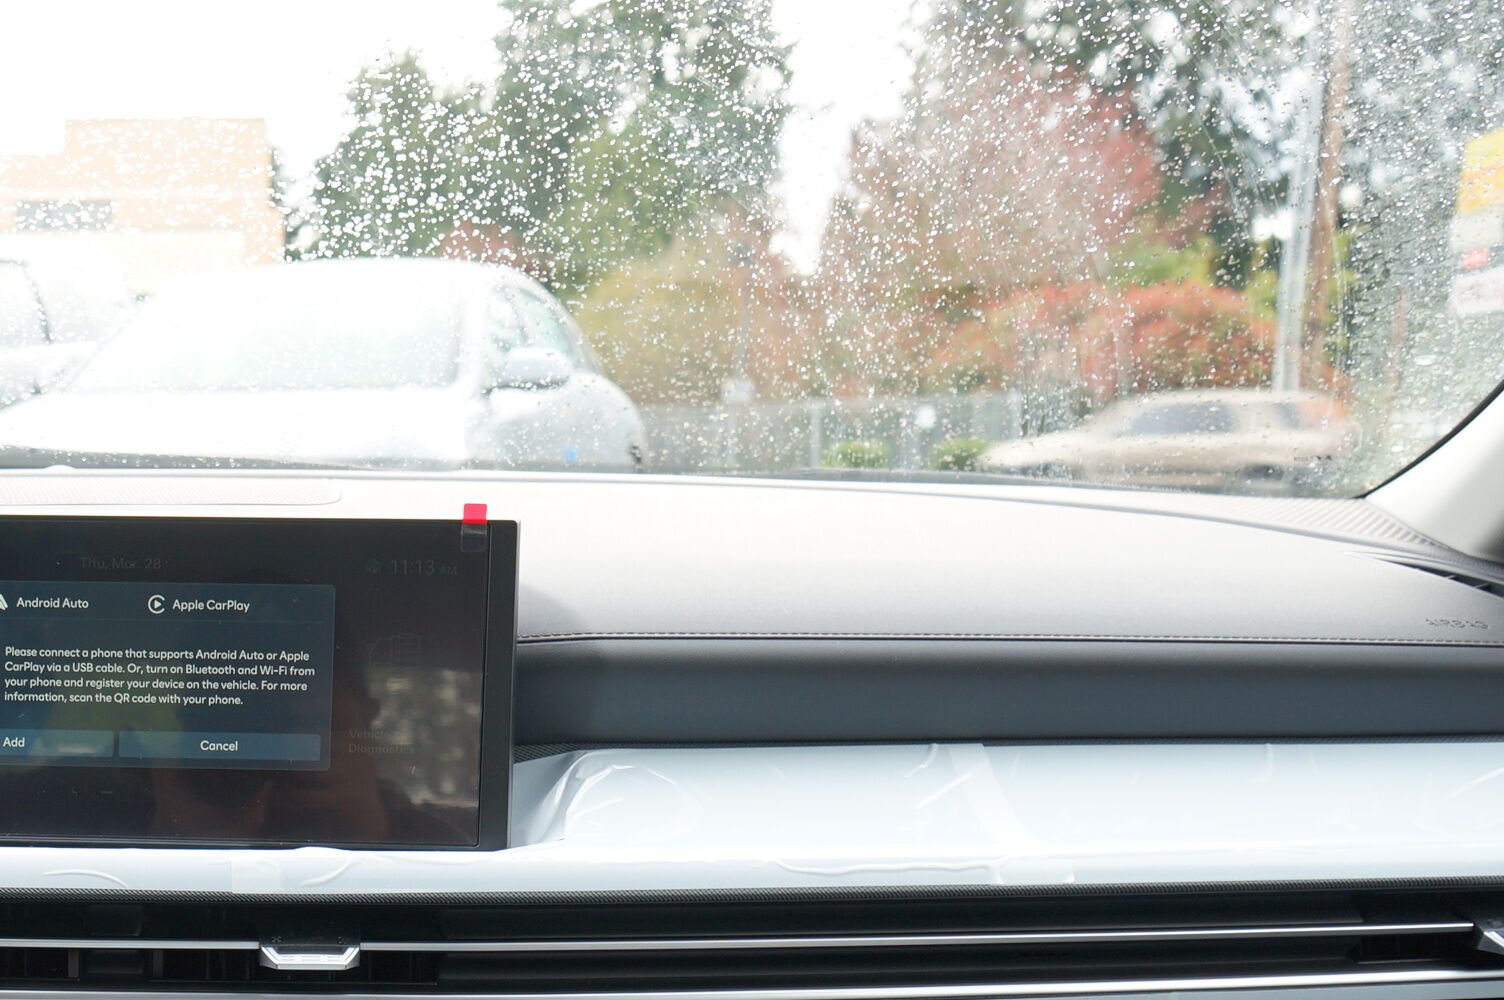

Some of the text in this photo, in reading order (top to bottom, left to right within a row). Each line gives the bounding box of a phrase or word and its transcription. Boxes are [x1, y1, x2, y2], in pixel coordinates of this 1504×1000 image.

[144, 557, 162, 569] 28
[391, 559, 435, 576] 11:13
[16, 597, 89, 609] Android Auto
[172, 599, 250, 612] Apple CarPlay
[5, 646, 310, 662] Please connect a phone that supports Android Auto or Apple
[4, 661, 315, 676] CarPlay via a USB cable. Or, turn on Bluetooth and Wi-Fi from
[4, 677, 308, 691] your phone and register your device on the vehicle. For more
[4, 691, 243, 706] information, scan the QR code with your phone.
[3, 736, 25, 748] Add
[200, 740, 239, 752] Cancel
